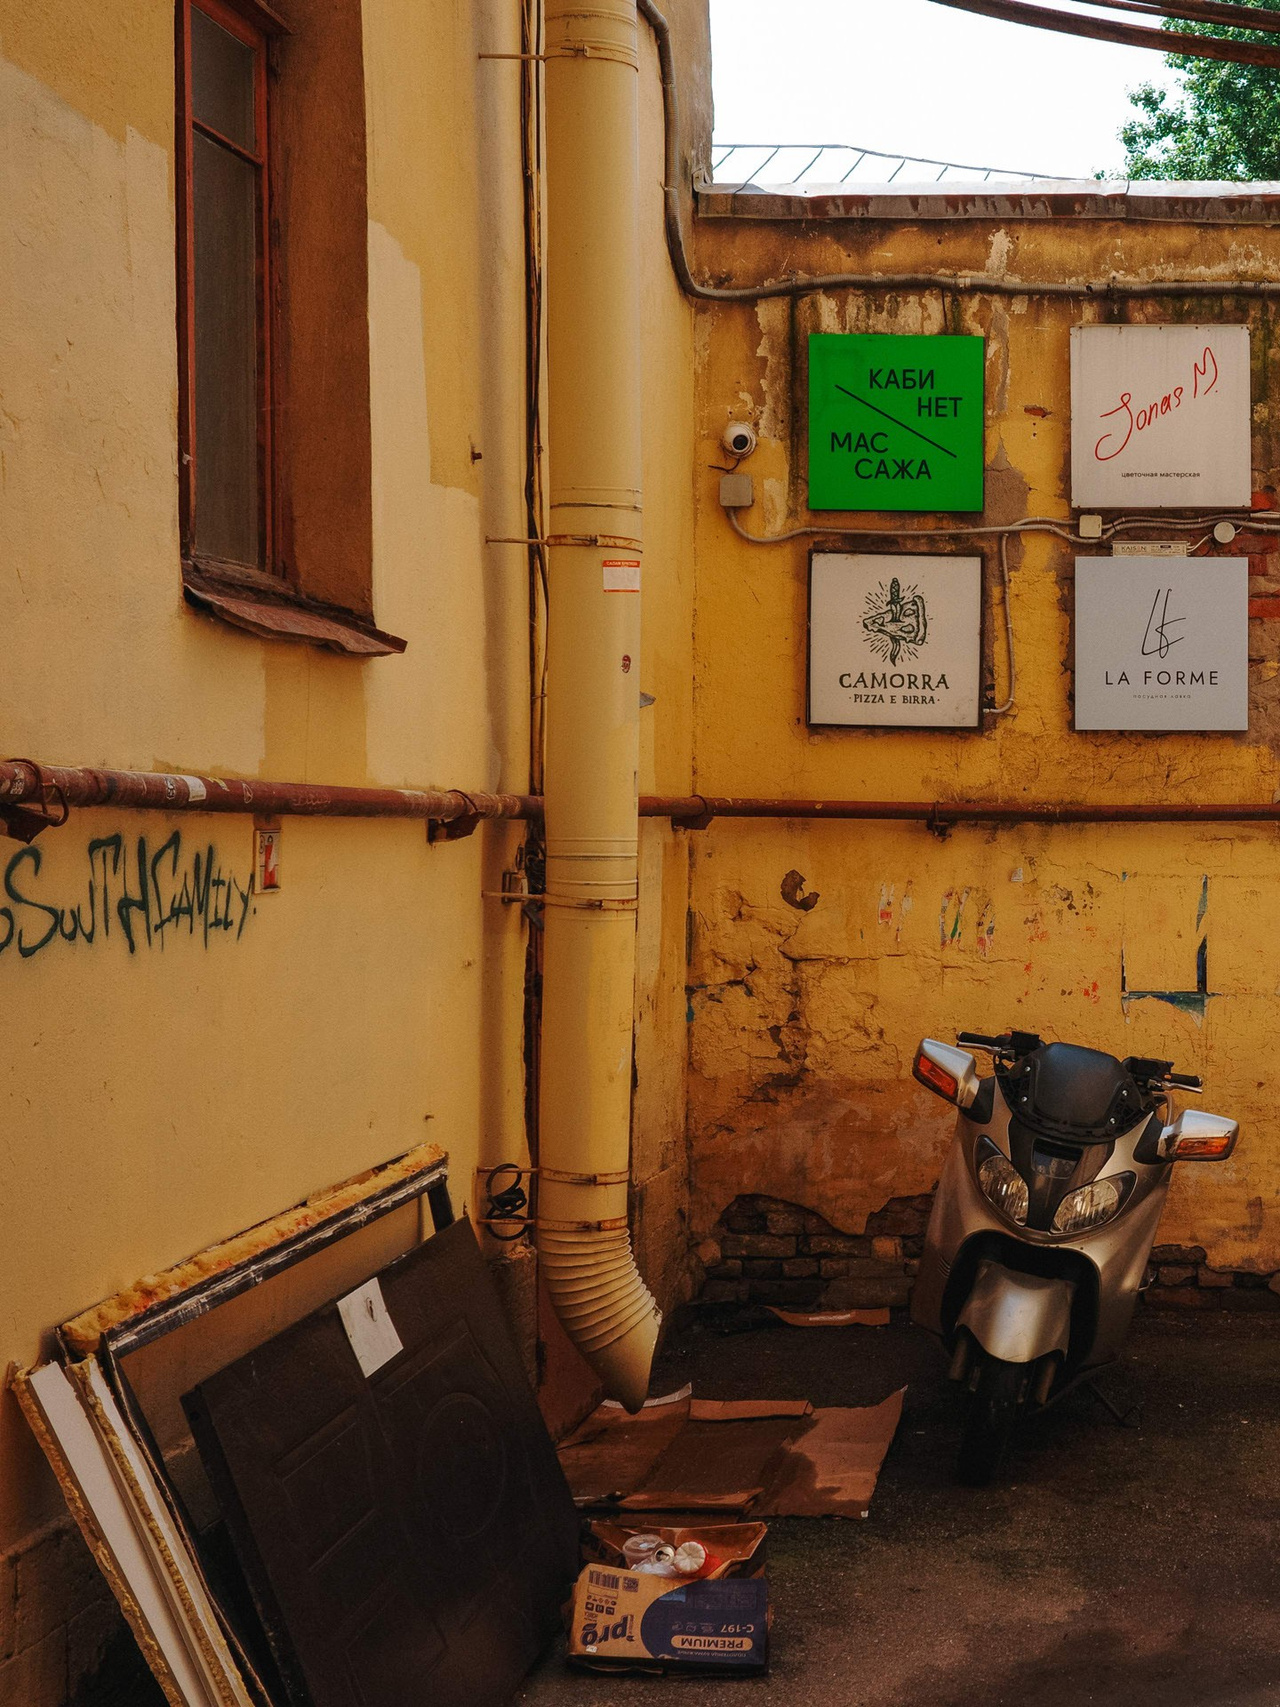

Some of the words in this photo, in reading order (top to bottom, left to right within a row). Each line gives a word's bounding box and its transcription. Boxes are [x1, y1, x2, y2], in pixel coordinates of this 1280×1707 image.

[869, 368, 936, 390] КАБИ
[917, 397, 963, 418] НЕТ
[1095, 386, 1184, 461] Jonas
[831, 432, 889, 453] МАС
[854, 458, 932, 481] САЖА
[1159, 471, 1201, 479] мастерская
[838, 672, 950, 691] CAMORRA
[1105, 670, 1131, 686] LA
[1144, 670, 1219, 686] FORME
[853, 693, 885, 704] PIZZA
[889, 695, 897, 704] E
[902, 695, 936, 705] BIRRA
[681, 1638, 744, 1649] PREMIUM
